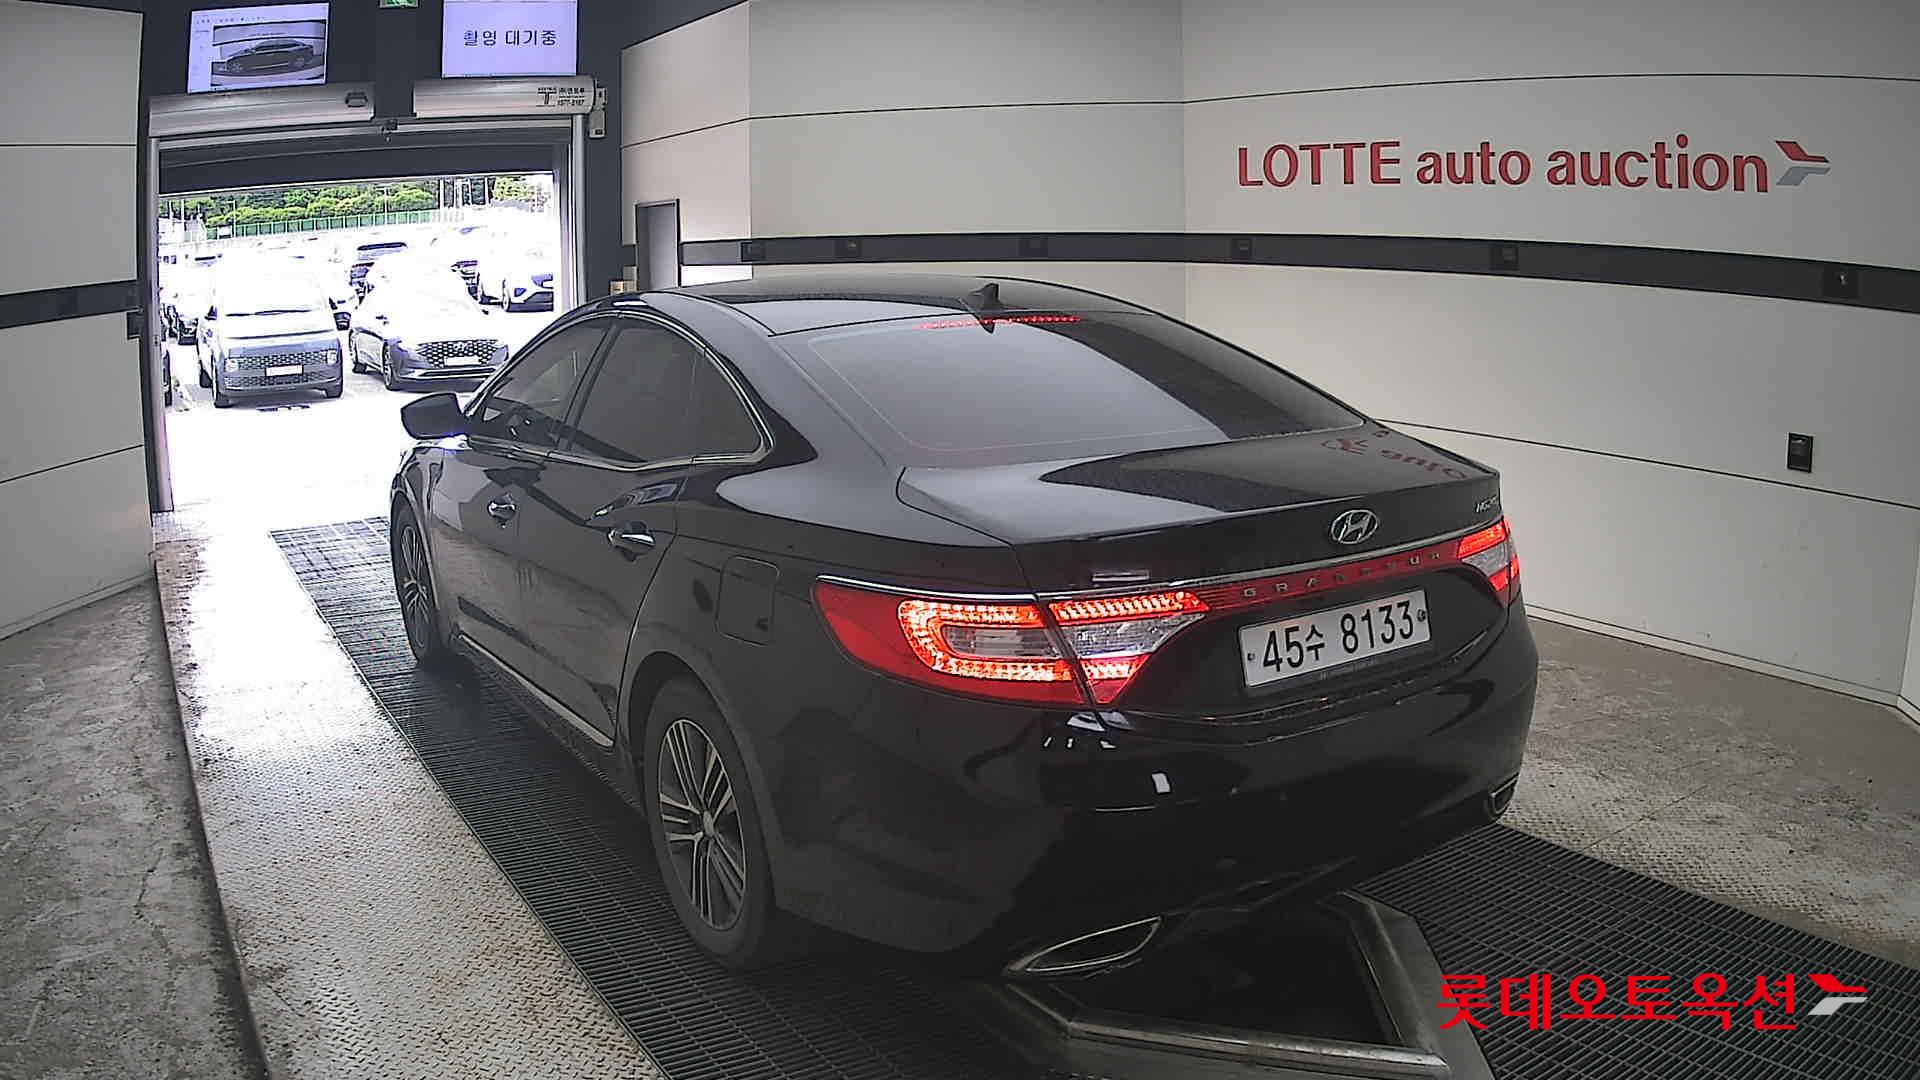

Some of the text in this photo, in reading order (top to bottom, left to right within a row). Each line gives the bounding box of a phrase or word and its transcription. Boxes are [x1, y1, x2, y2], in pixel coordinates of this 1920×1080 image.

[505, 29, 557, 46] 대기중
[1238, 133, 1768, 193] LOTTE auto auction
[1262, 600, 1414, 673] 45수 8133
